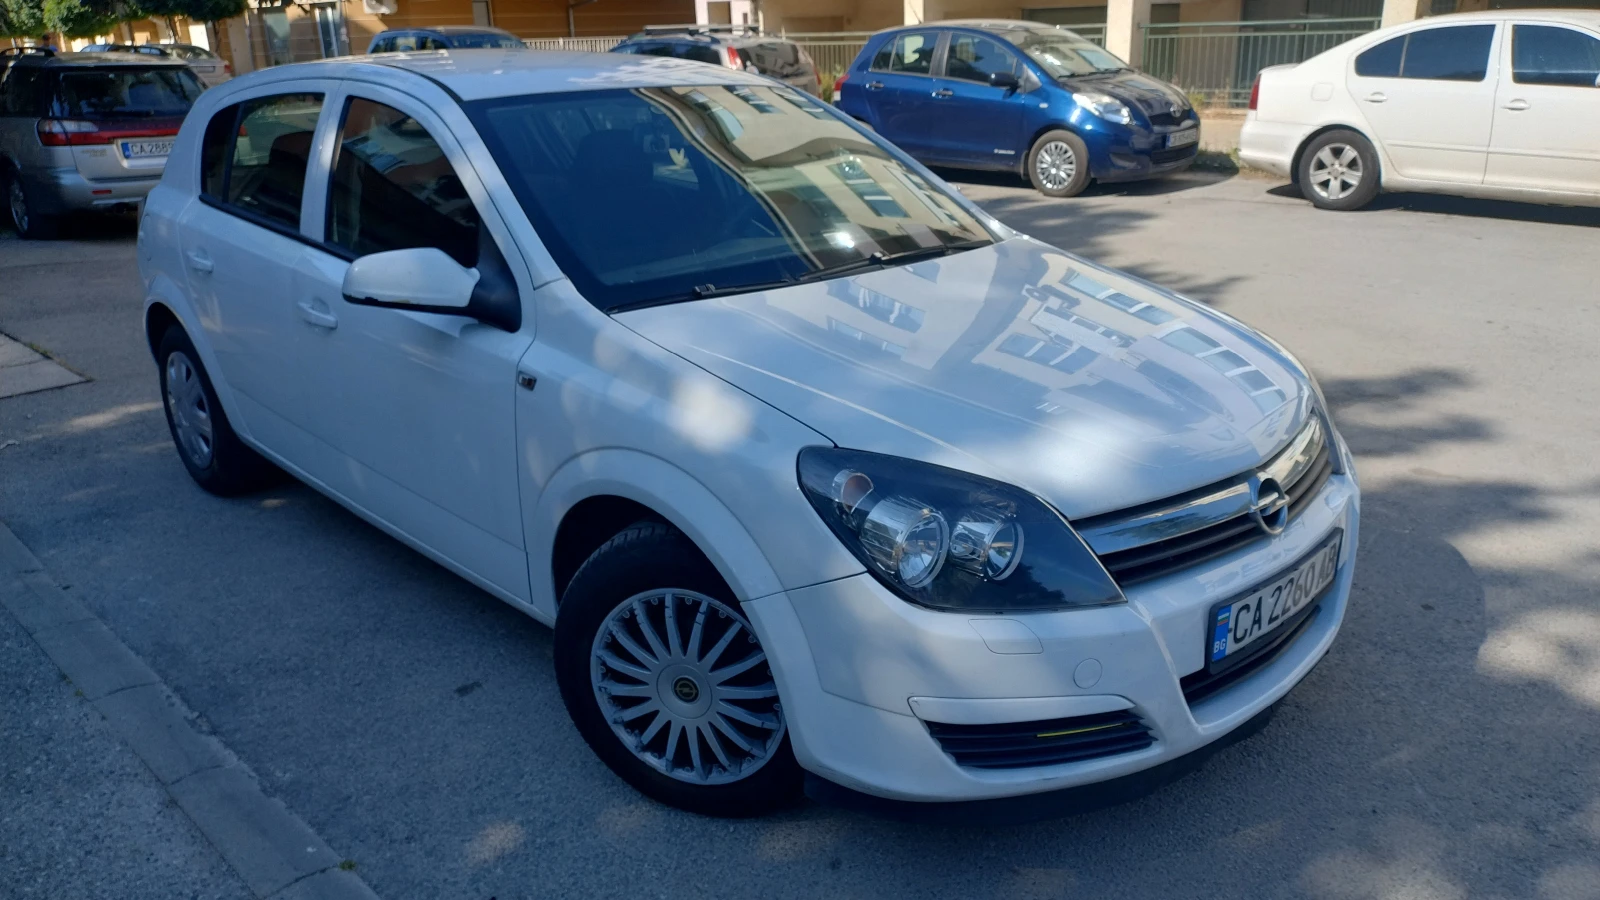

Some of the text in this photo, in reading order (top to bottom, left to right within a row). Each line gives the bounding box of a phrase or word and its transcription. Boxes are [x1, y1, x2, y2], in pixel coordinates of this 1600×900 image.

[131, 144, 146, 155] CA
[1233, 542, 1337, 644] CA 2260 AB
[1213, 638, 1227, 654] BG
